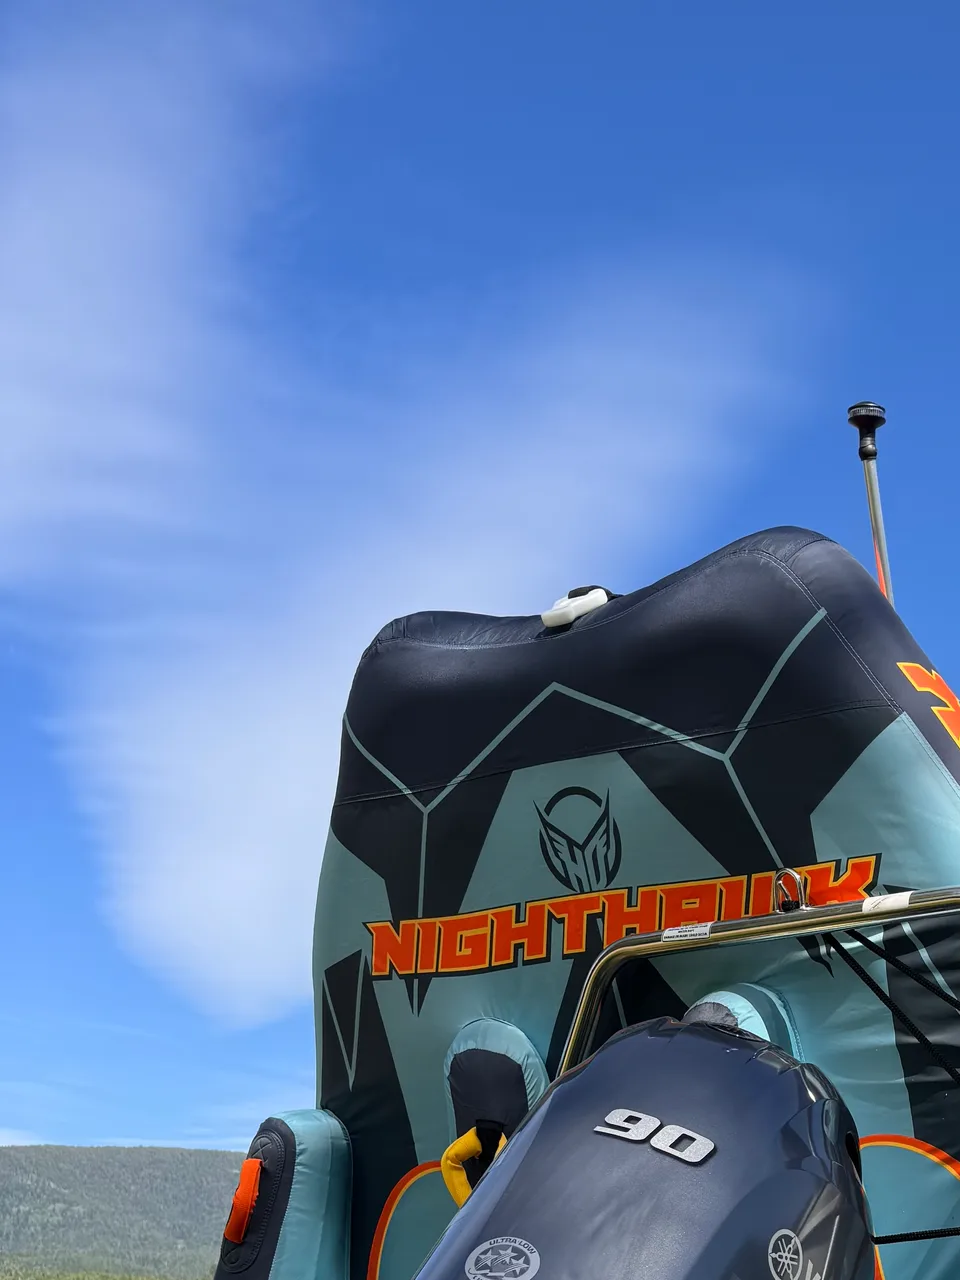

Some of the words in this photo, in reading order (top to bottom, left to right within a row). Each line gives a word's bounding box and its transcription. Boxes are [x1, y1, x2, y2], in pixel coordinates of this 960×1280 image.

[366, 854, 881, 977] NIGHTHAWK
[593, 1108, 715, 1164] 90
[489, 1237, 517, 1246] ULTRA
[518, 1240, 537, 1255] LOW
